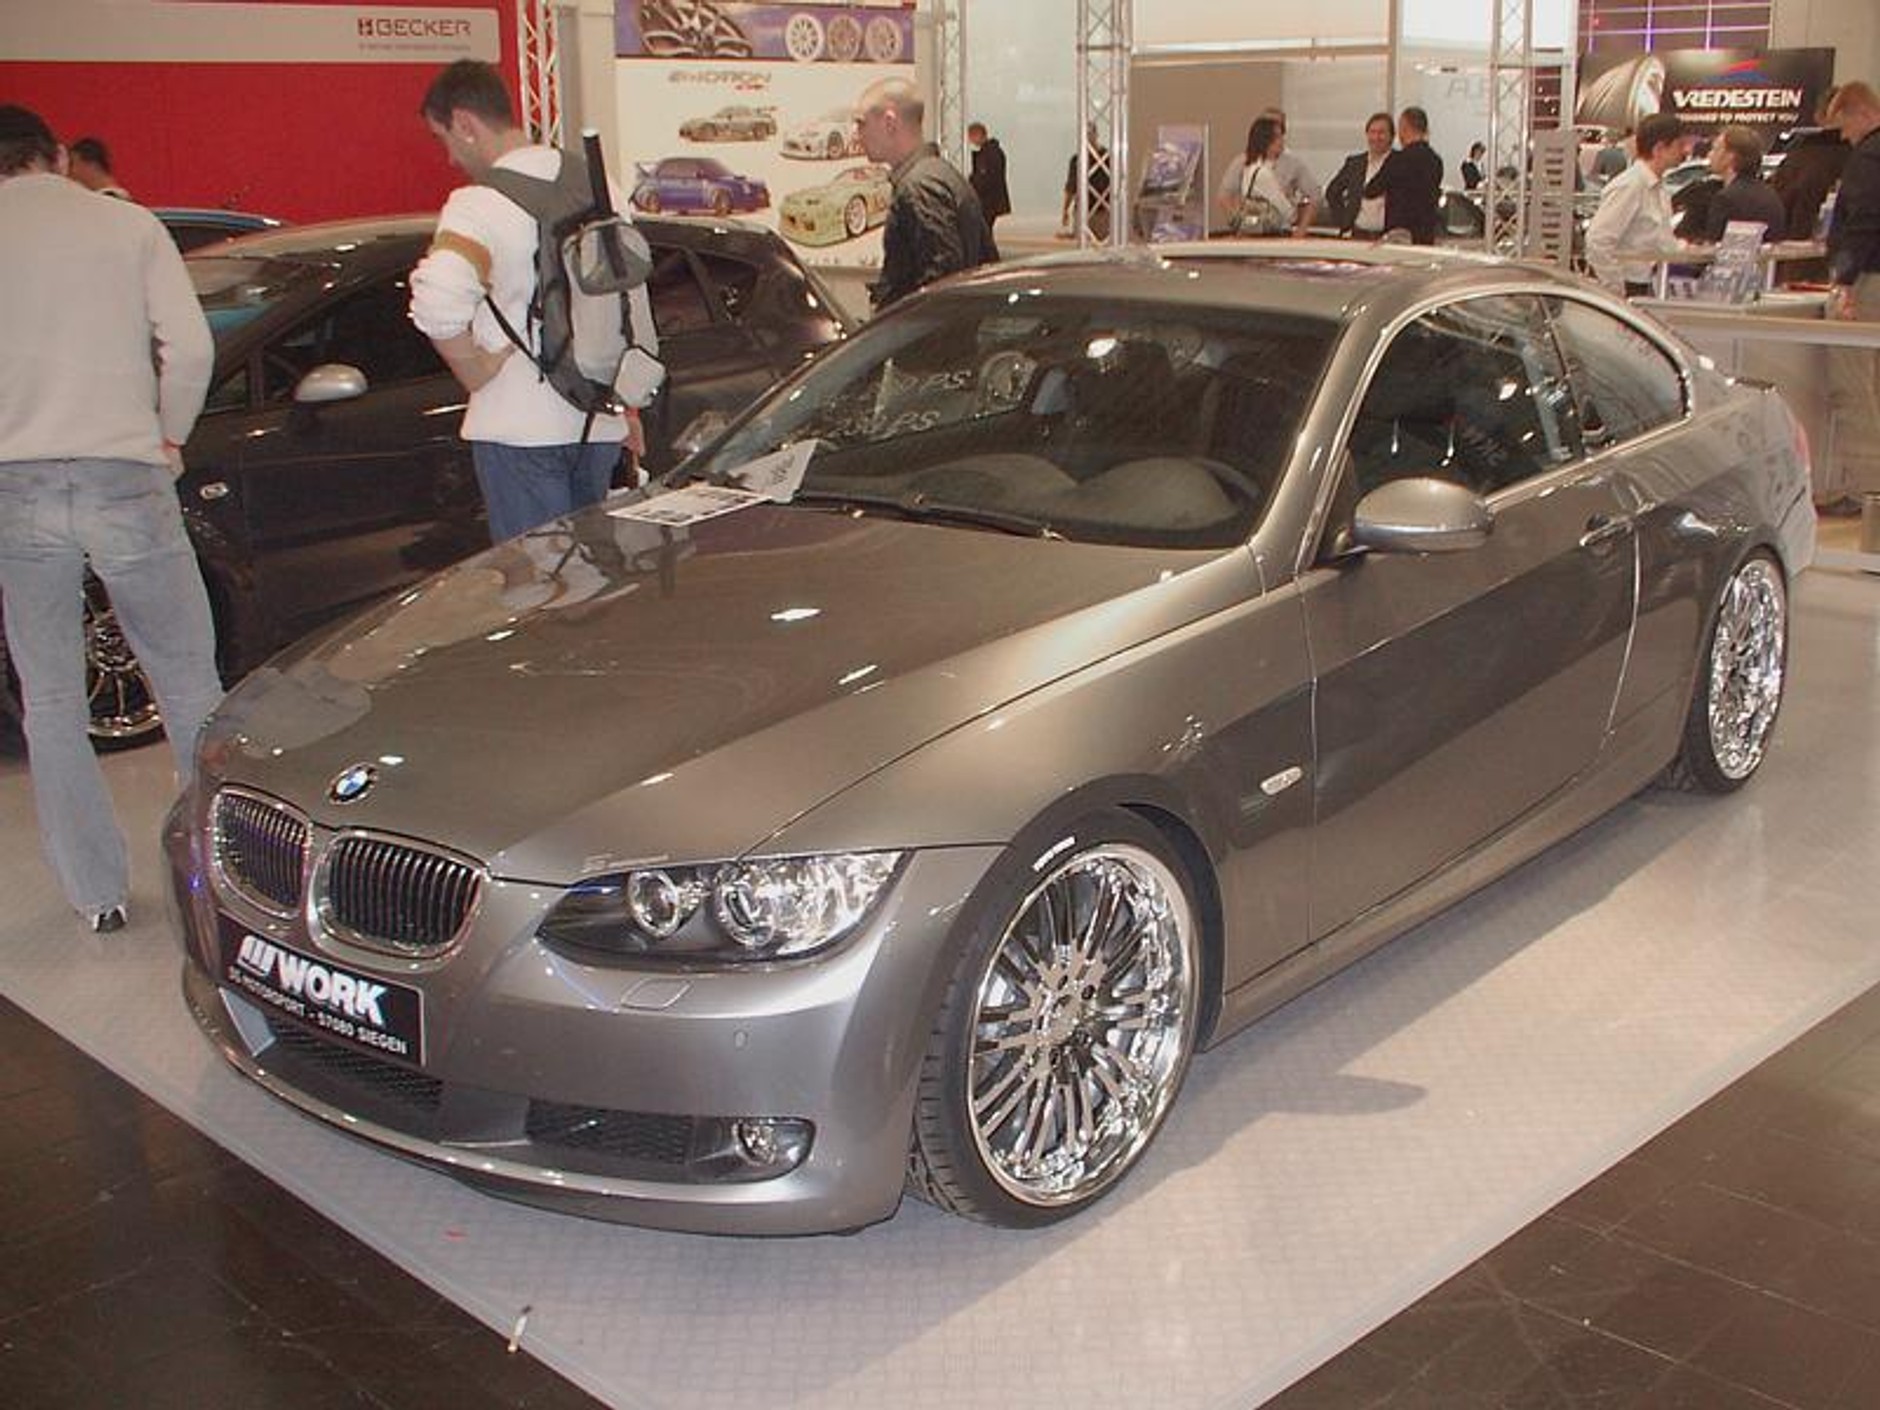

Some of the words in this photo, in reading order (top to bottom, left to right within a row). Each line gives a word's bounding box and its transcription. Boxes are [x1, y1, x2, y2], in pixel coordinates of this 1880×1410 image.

[376, 18, 471, 37] BECKER
[1672, 88, 1803, 108] VREDESTEIN
[277, 948, 386, 1027] WORK
